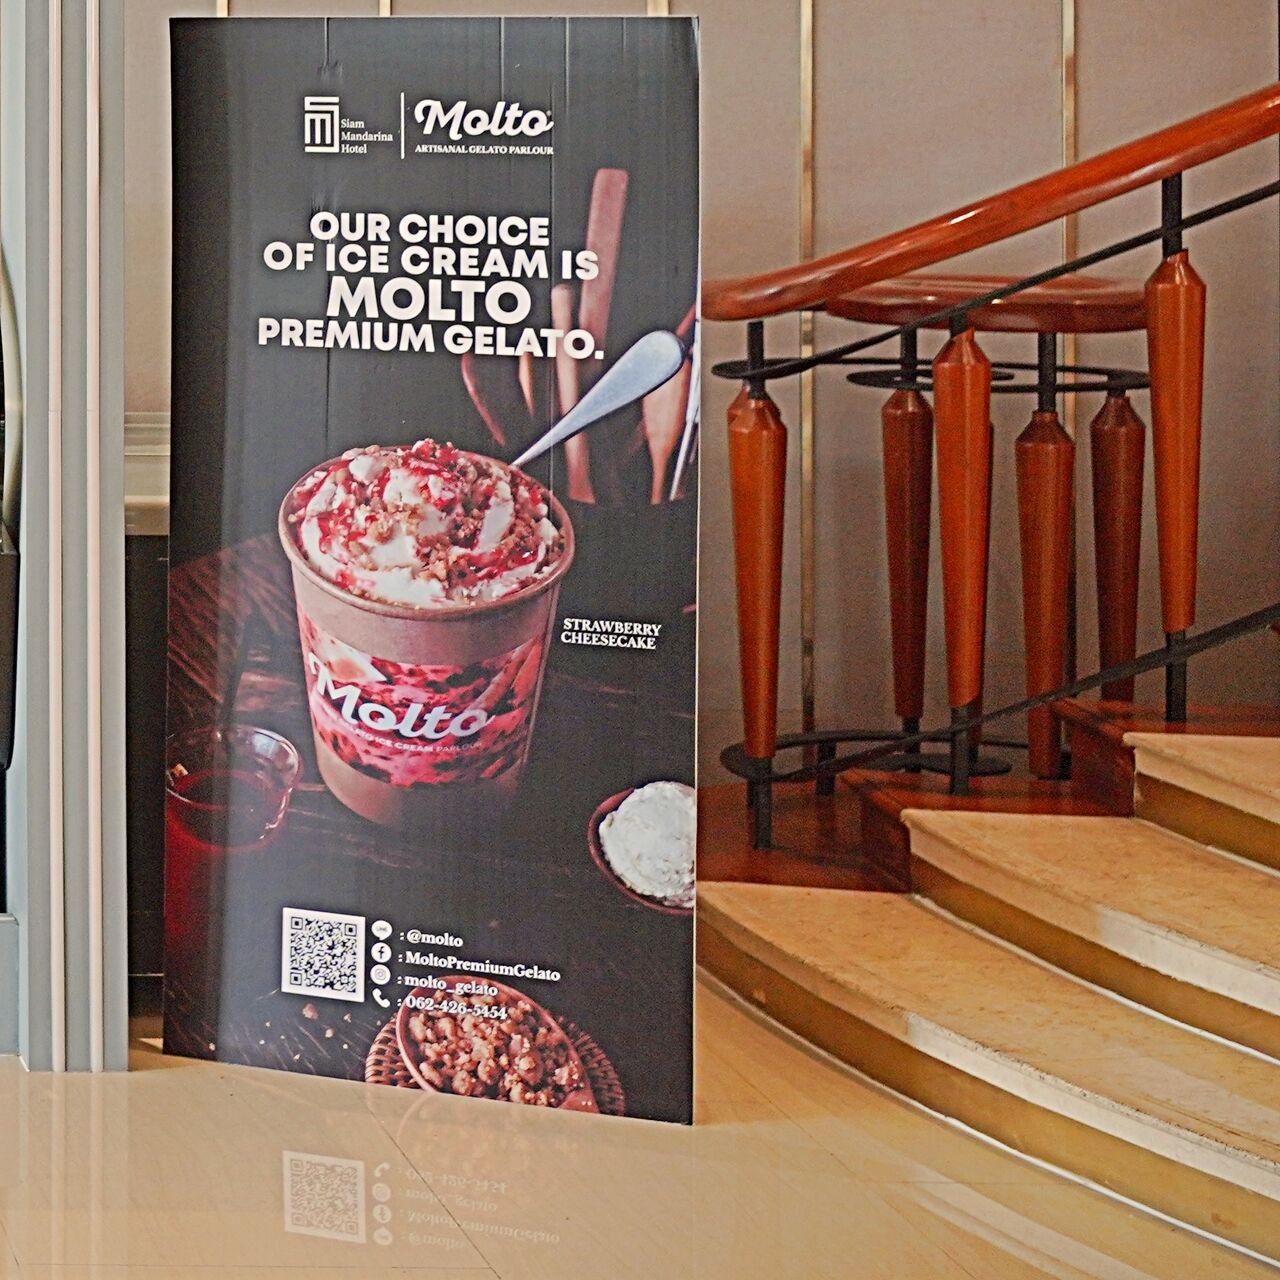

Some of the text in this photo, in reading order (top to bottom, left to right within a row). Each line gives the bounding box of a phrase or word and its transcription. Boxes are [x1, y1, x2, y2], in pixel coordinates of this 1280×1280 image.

[341, 119, 365, 129] Siam
[341, 131, 393, 142] Mandarina
[341, 143, 368, 154] Hotel
[414, 144, 554, 155] ARTISANAL GELATO PARLOUR
[310, 211, 550, 247] OUR CHOICE
[263, 241, 600, 280] OF ICE CREAM IS
[326, 275, 532, 325] MOLTO
[258, 317, 605, 360] PREMIUM GELATO.
[563, 617, 662, 637] STRAWBERRY
[560, 631, 656, 650] CHEESECAKE
[308, 651, 496, 740] Molto
[393, 740, 434, 752] CREAM
[406, 928, 464, 948] @molto
[405, 950, 561, 981] MoltoPremiumGelato
[404, 974, 499, 997] molto_gelato
[405, 995, 508, 1020] 062-426-5454
